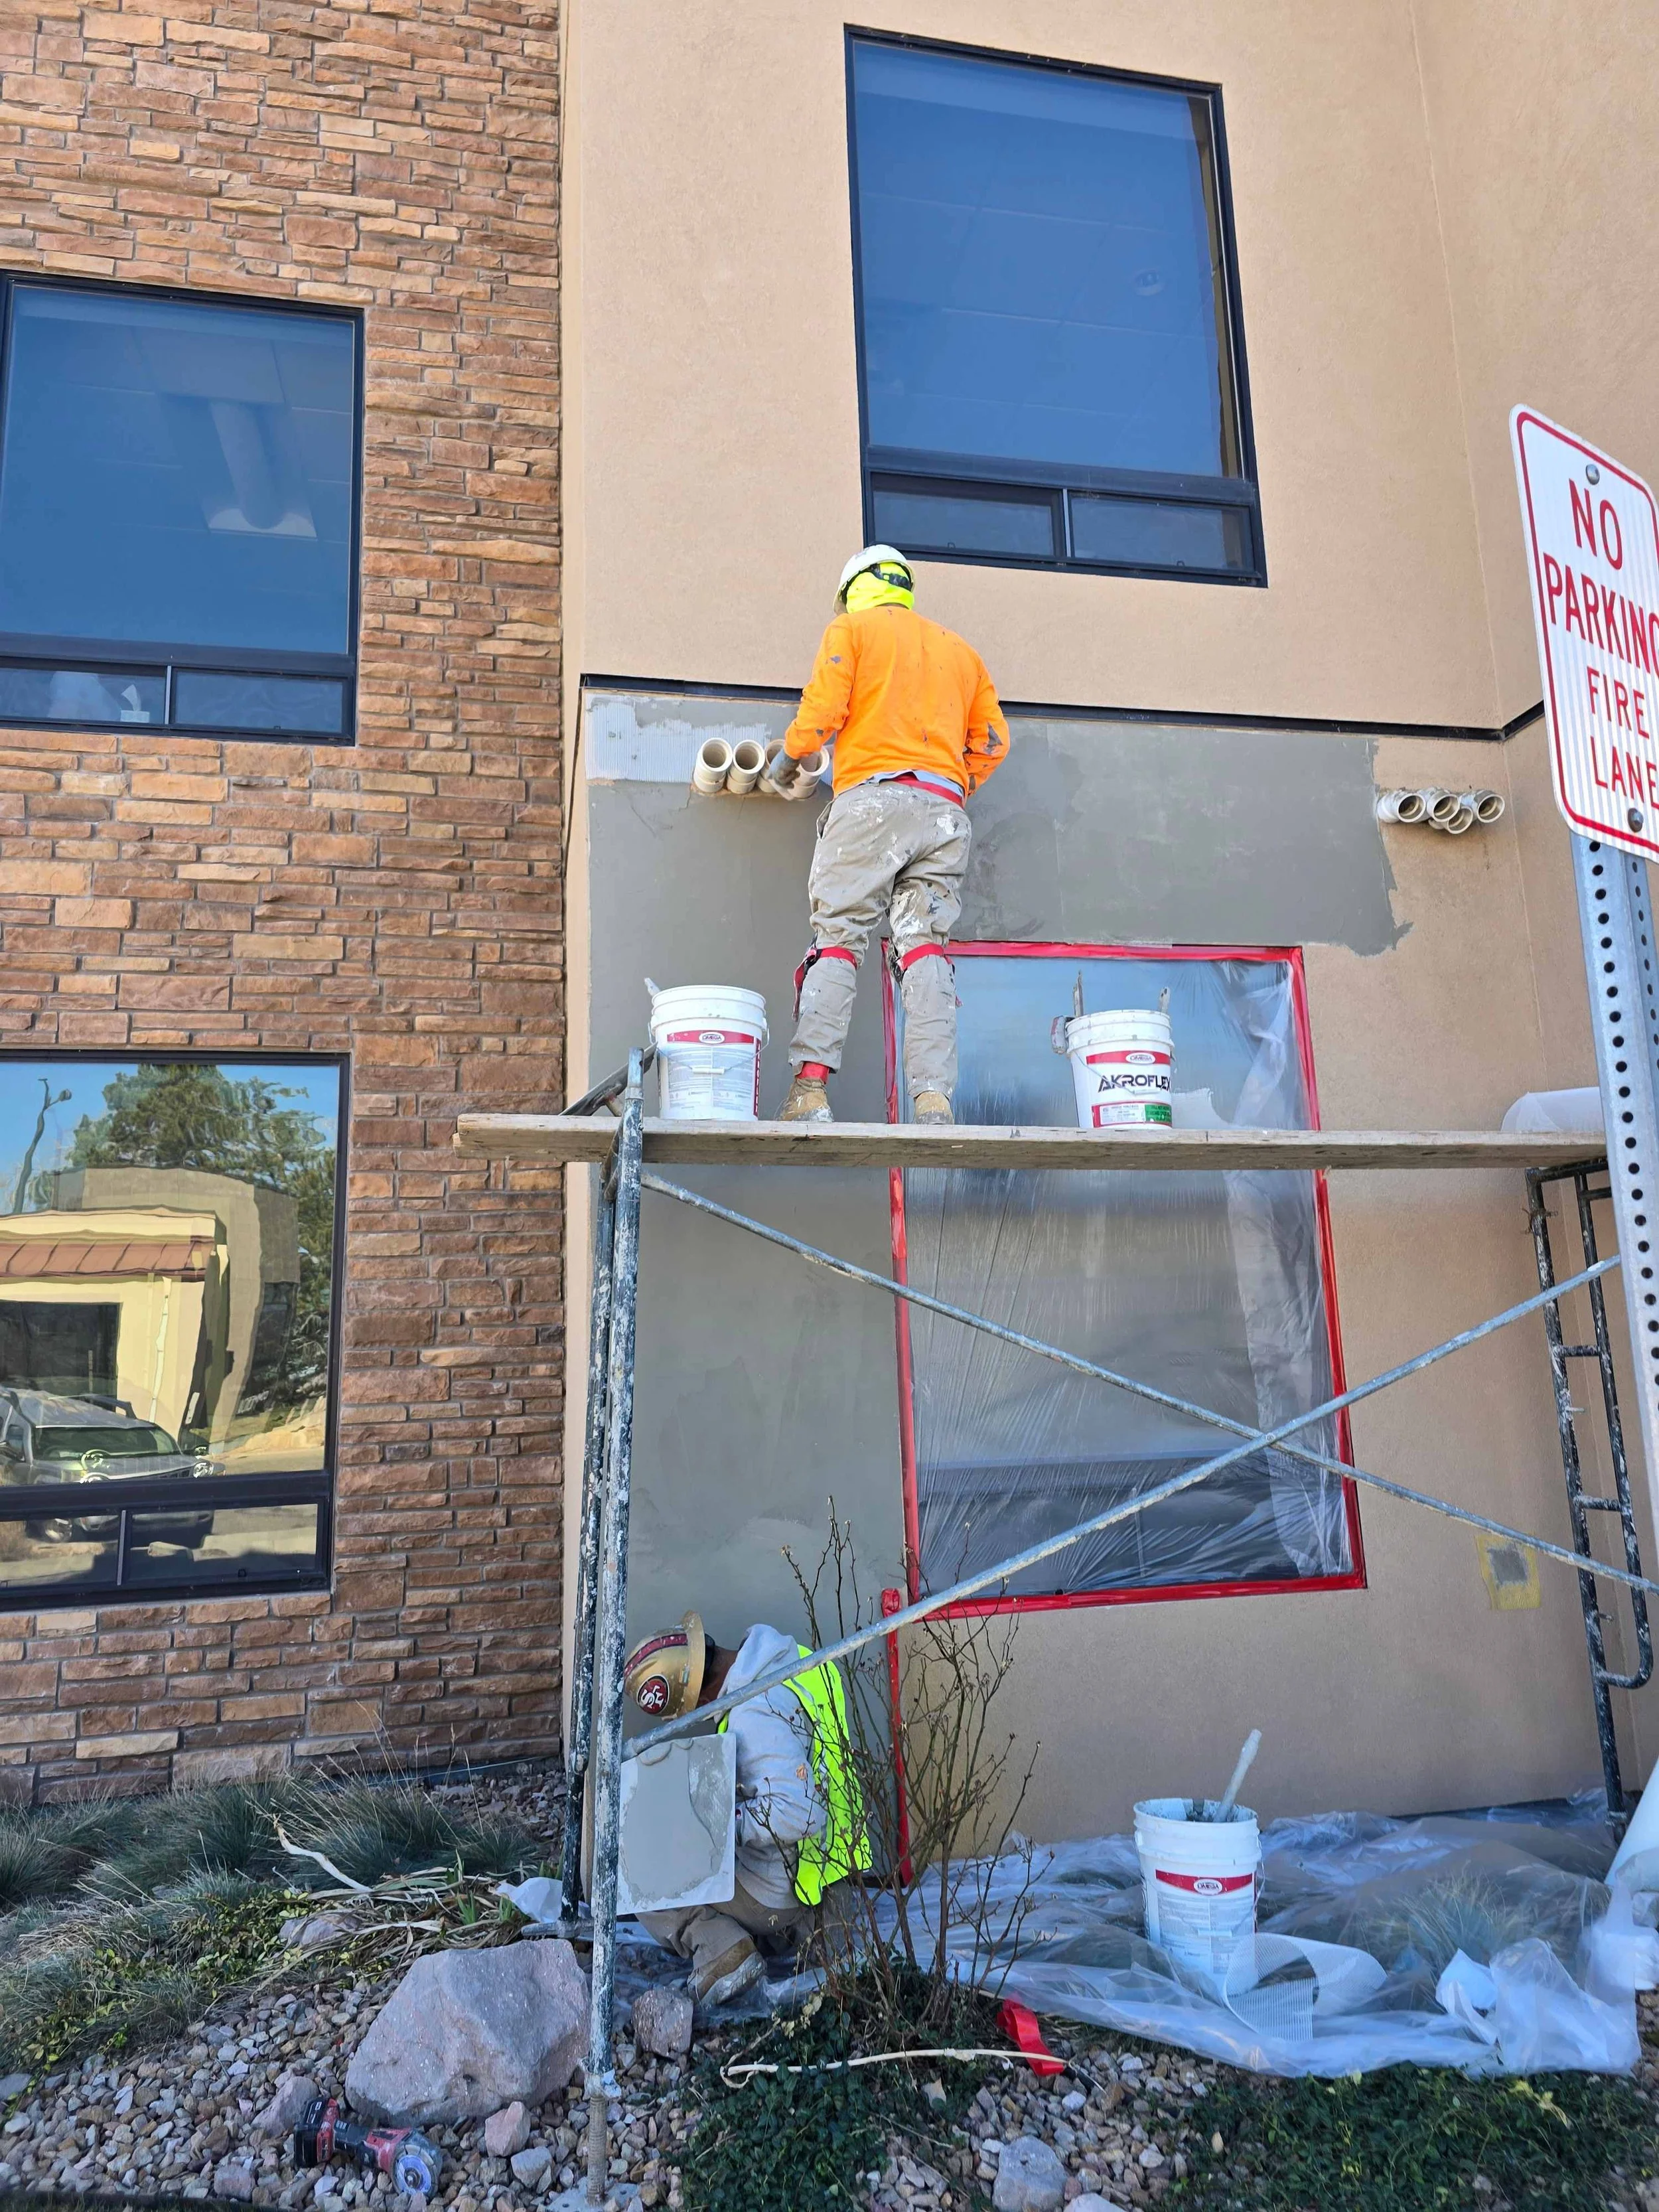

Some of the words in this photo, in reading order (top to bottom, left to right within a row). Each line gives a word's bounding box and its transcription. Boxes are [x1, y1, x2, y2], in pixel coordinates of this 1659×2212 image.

[1569, 477, 1623, 570] NO
[1587, 666, 1650, 740] FIRE
[1590, 735, 1659, 810] LANE
